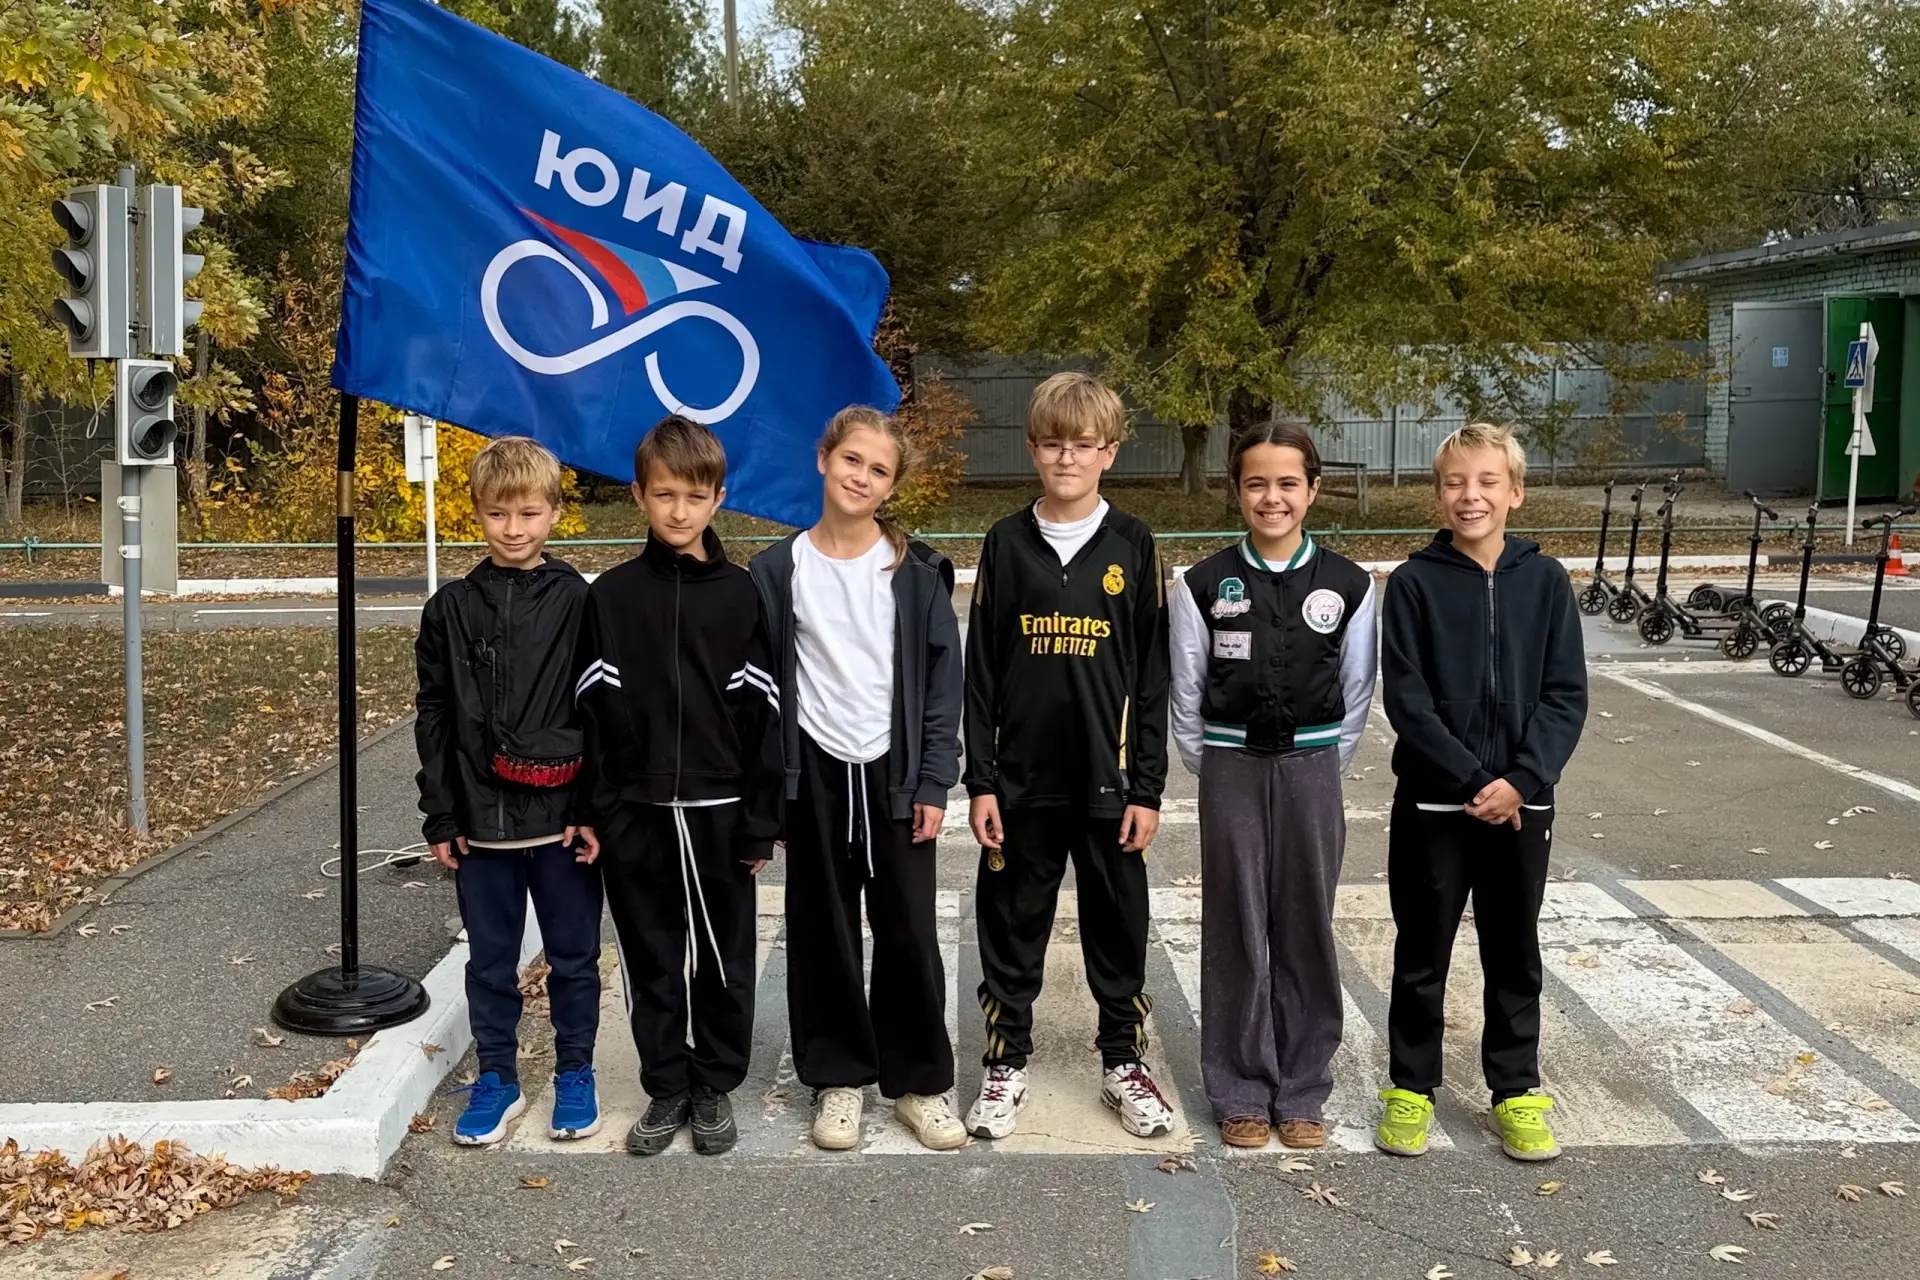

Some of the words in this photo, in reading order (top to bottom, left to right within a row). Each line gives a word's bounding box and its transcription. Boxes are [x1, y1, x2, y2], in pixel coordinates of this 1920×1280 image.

[534, 129, 747, 274] ЮИД
[1020, 611, 1111, 638] Emirates
[1030, 636, 1051, 655] FLY
[1053, 636, 1097, 657] BETTER
